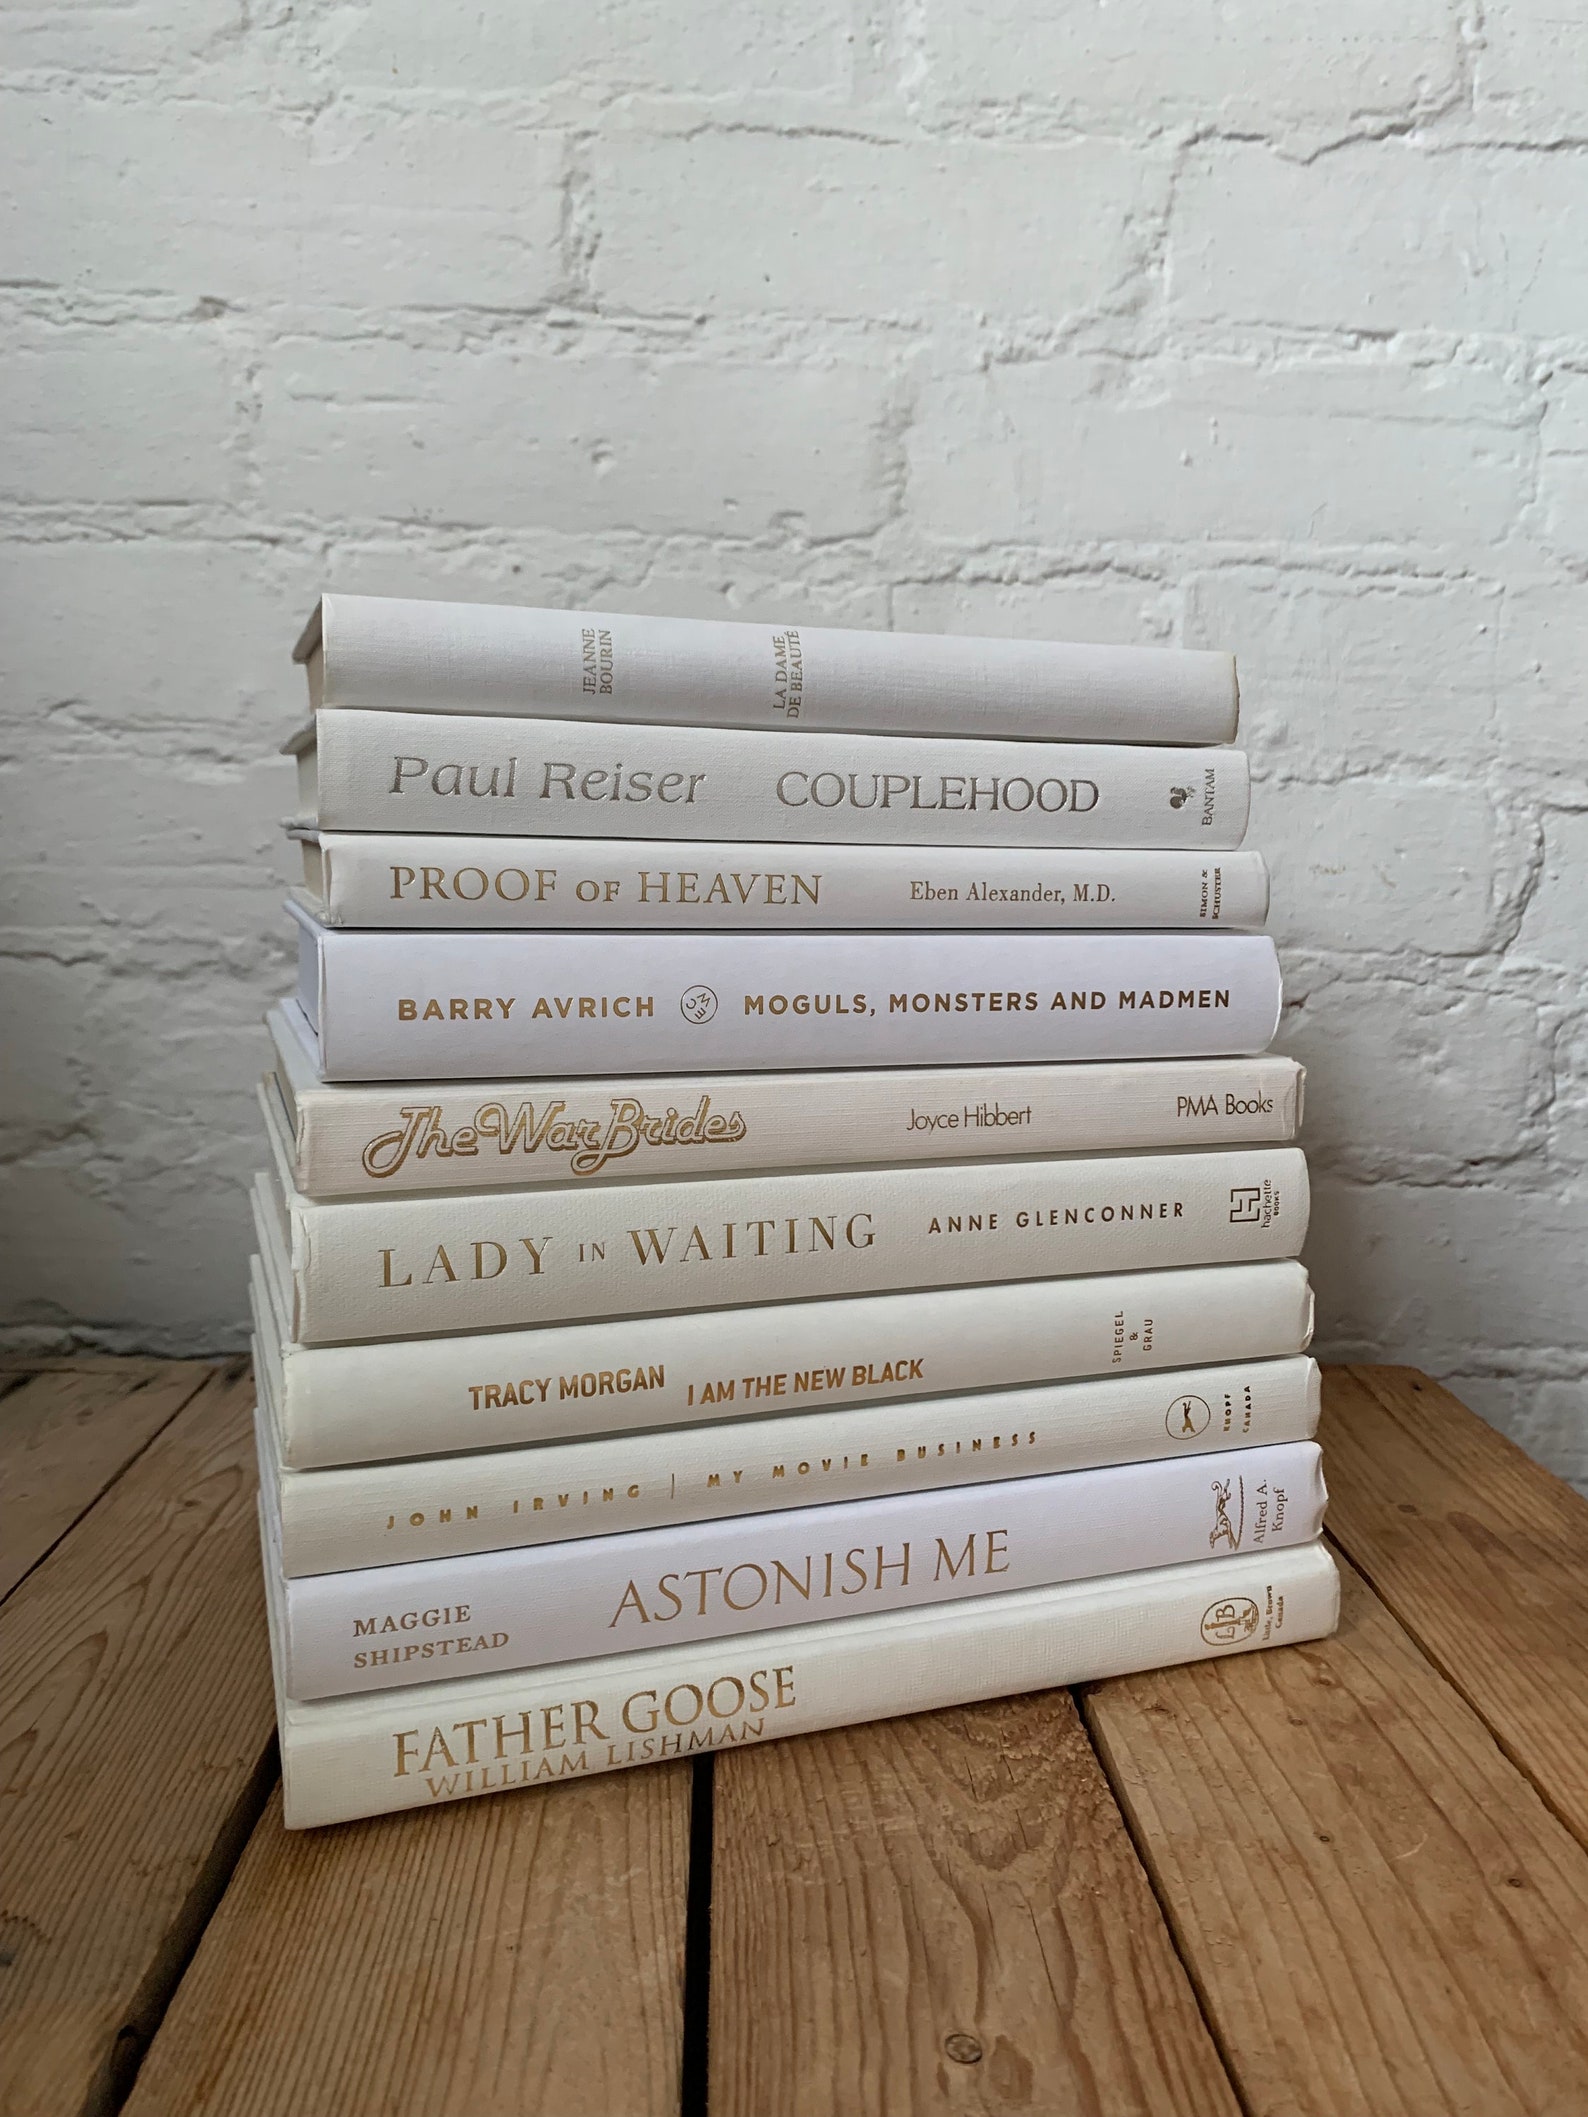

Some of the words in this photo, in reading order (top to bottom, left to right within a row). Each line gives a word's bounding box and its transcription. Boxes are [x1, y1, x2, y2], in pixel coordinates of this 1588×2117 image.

[582, 628, 597, 695] JEANNE
[599, 629, 613, 695] BOURIN
[772, 635, 788, 683] DAME
[784, 630, 803, 692] BEAUTÉ
[773, 689, 787, 710] LA
[787, 697, 801, 719] DE
[388, 756, 518, 798] Paul
[539, 763, 708, 804] Reiser
[776, 771, 1100, 812] COUPLEHOOD
[1201, 768, 1216, 826] BANTAM
[389, 866, 557, 902] PROOF
[575, 879, 621, 902] OF
[638, 870, 823, 905] HEAVEN
[910, 880, 959, 901] Eben
[966, 881, 1066, 905] Alexander,
[1073, 884, 1117, 903] M.D.
[1200, 882, 1209, 918] SIMON
[1212, 867, 1222, 920] SCHUSTER
[397, 997, 516, 1021] BARRY
[531, 996, 655, 1020] AVRICH
[743, 993, 877, 1017] MOGULS,
[888, 992, 1039, 1013] MONSTERS
[1051, 990, 1107, 1011] AND
[1118, 989, 1231, 1009] MADMEN
[906, 1108, 960, 1134] Joyce
[963, 1105, 1033, 1128] Hibbert
[1177, 1094, 1219, 1117] PMA
[1225, 1090, 1273, 1115] Books
[362, 1105, 479, 1178] The
[474, 1101, 602, 1154] War
[571, 1095, 748, 1176] Brides
[928, 1213, 998, 1235] ANNE
[1016, 1202, 1185, 1228] GLENCONNER
[1261, 1179, 1272, 1229] hachette
[378, 1236, 554, 1288] LADY
[578, 1241, 606, 1263] IN
[626, 1212, 877, 1266] WAITING
[1112, 1310, 1125, 1364] SPIEGEL
[1129, 1331, 1139, 1341] &
[1142, 1319, 1153, 1352] GRAU
[468, 1377, 553, 1411] TRACY
[558, 1364, 666, 1400] MORGAN
[687, 1384, 695, 1407] I
[699, 1379, 735, 1405] AM
[743, 1373, 787, 1399] THE
[793, 1366, 847, 1393] NEW
[851, 1358, 925, 1386] BLACK
[1223, 1393, 1232, 1432] KNOPF
[1242, 1385, 1252, 1433] CANADA
[707, 1470, 743, 1488] MY
[772, 1453, 869, 1479] MOVIE
[896, 1431, 1036, 1462] BUSINESS
[386, 1505, 479, 1530] JOHN
[513, 1484, 640, 1514] IRVING
[1256, 1479, 1268, 1496] A.
[1271, 1486, 1289, 1532] Knopf
[1253, 1501, 1268, 1544] Alfred
[607, 1541, 911, 1629] ASTONISH
[933, 1529, 1011, 1581] ME
[352, 1604, 471, 1637] MAGGIE
[354, 1632, 510, 1669] SHIPSTEAD
[392, 1700, 610, 1778] FATHER
[621, 1665, 797, 1734] GOOSE
[425, 1748, 590, 1798] WILLIAM
[606, 1716, 766, 1766] LISHMAN
